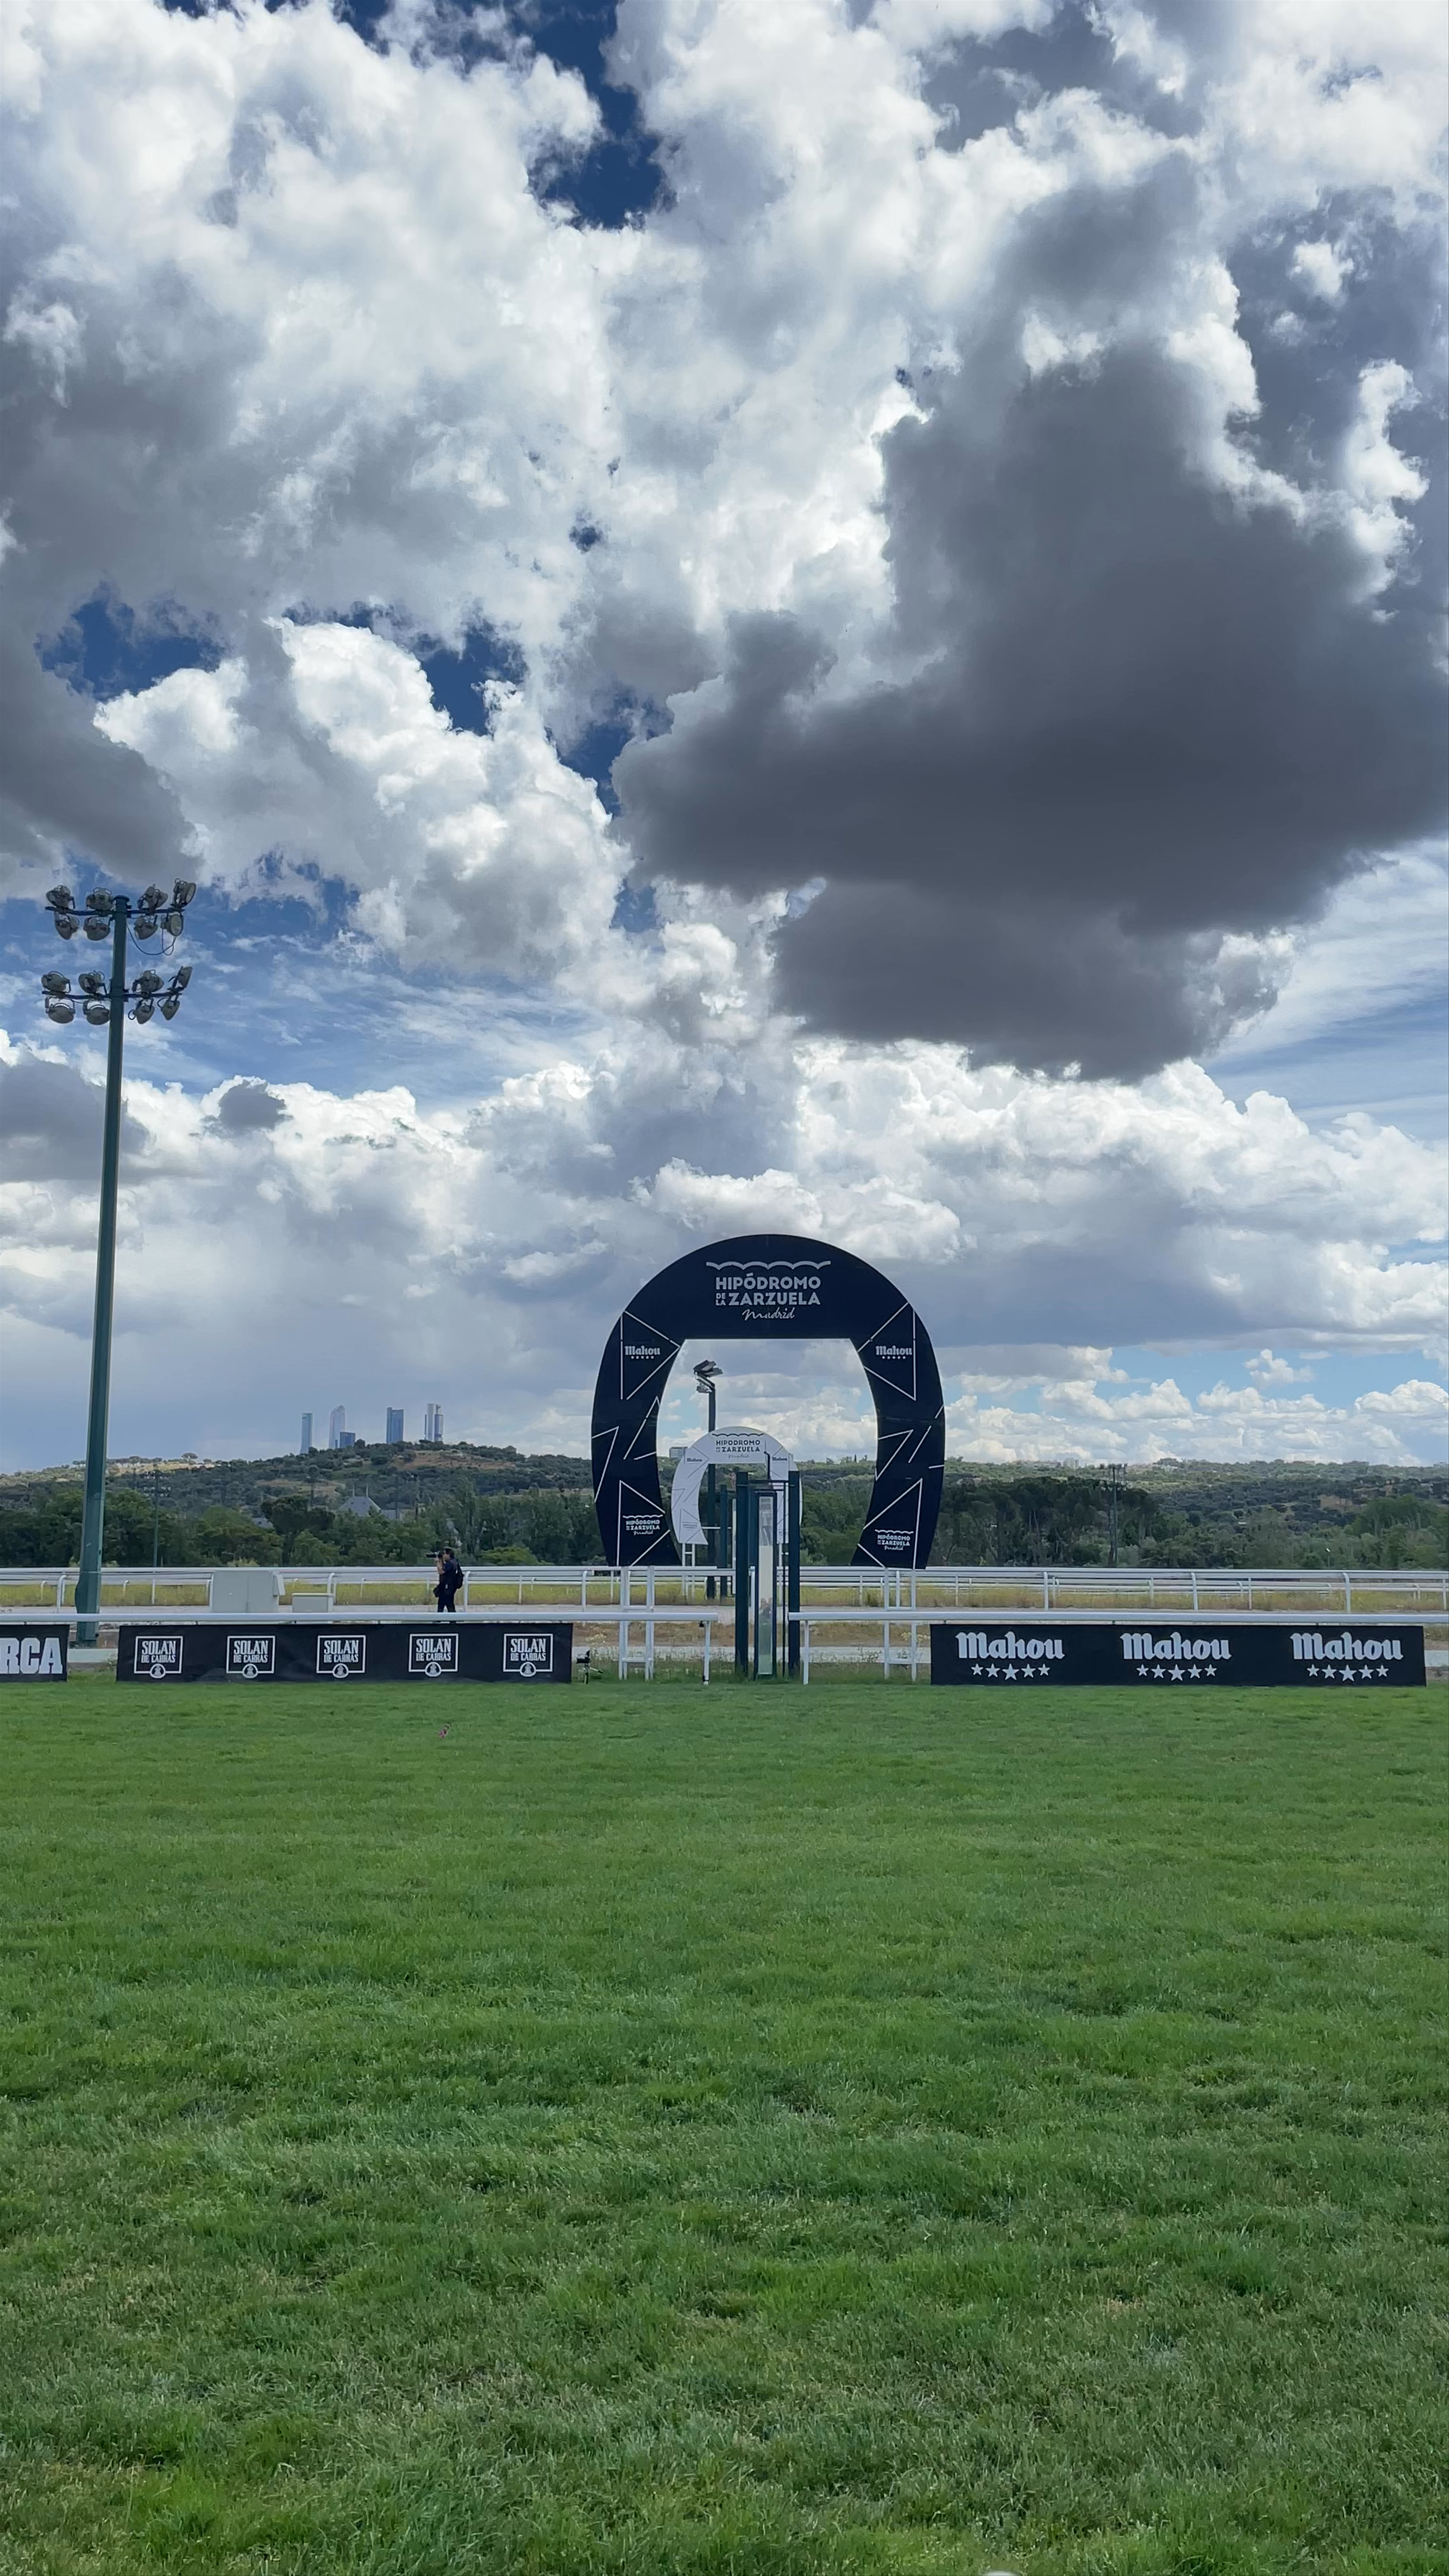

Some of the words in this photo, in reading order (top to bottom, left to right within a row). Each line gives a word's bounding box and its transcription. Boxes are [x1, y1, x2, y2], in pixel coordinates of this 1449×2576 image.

[715, 1273, 821, 1290] HIPÓDROMO
[729, 1292, 821, 1306] ZARZUELA
[742, 1307, 795, 1321] Madrid
[625, 1346, 660, 1355] Mahou
[875, 1345, 912, 1355] Mahou
[955, 1631, 1065, 1659] Mahou
[1119, 1632, 1232, 1659] Mahou
[1289, 1632, 1404, 1660] Mahou
[233, 1654, 242, 1663] DE
[324, 1654, 332, 1663] DE
[416, 1653, 425, 1661] DE
[510, 1652, 519, 1661] DE
